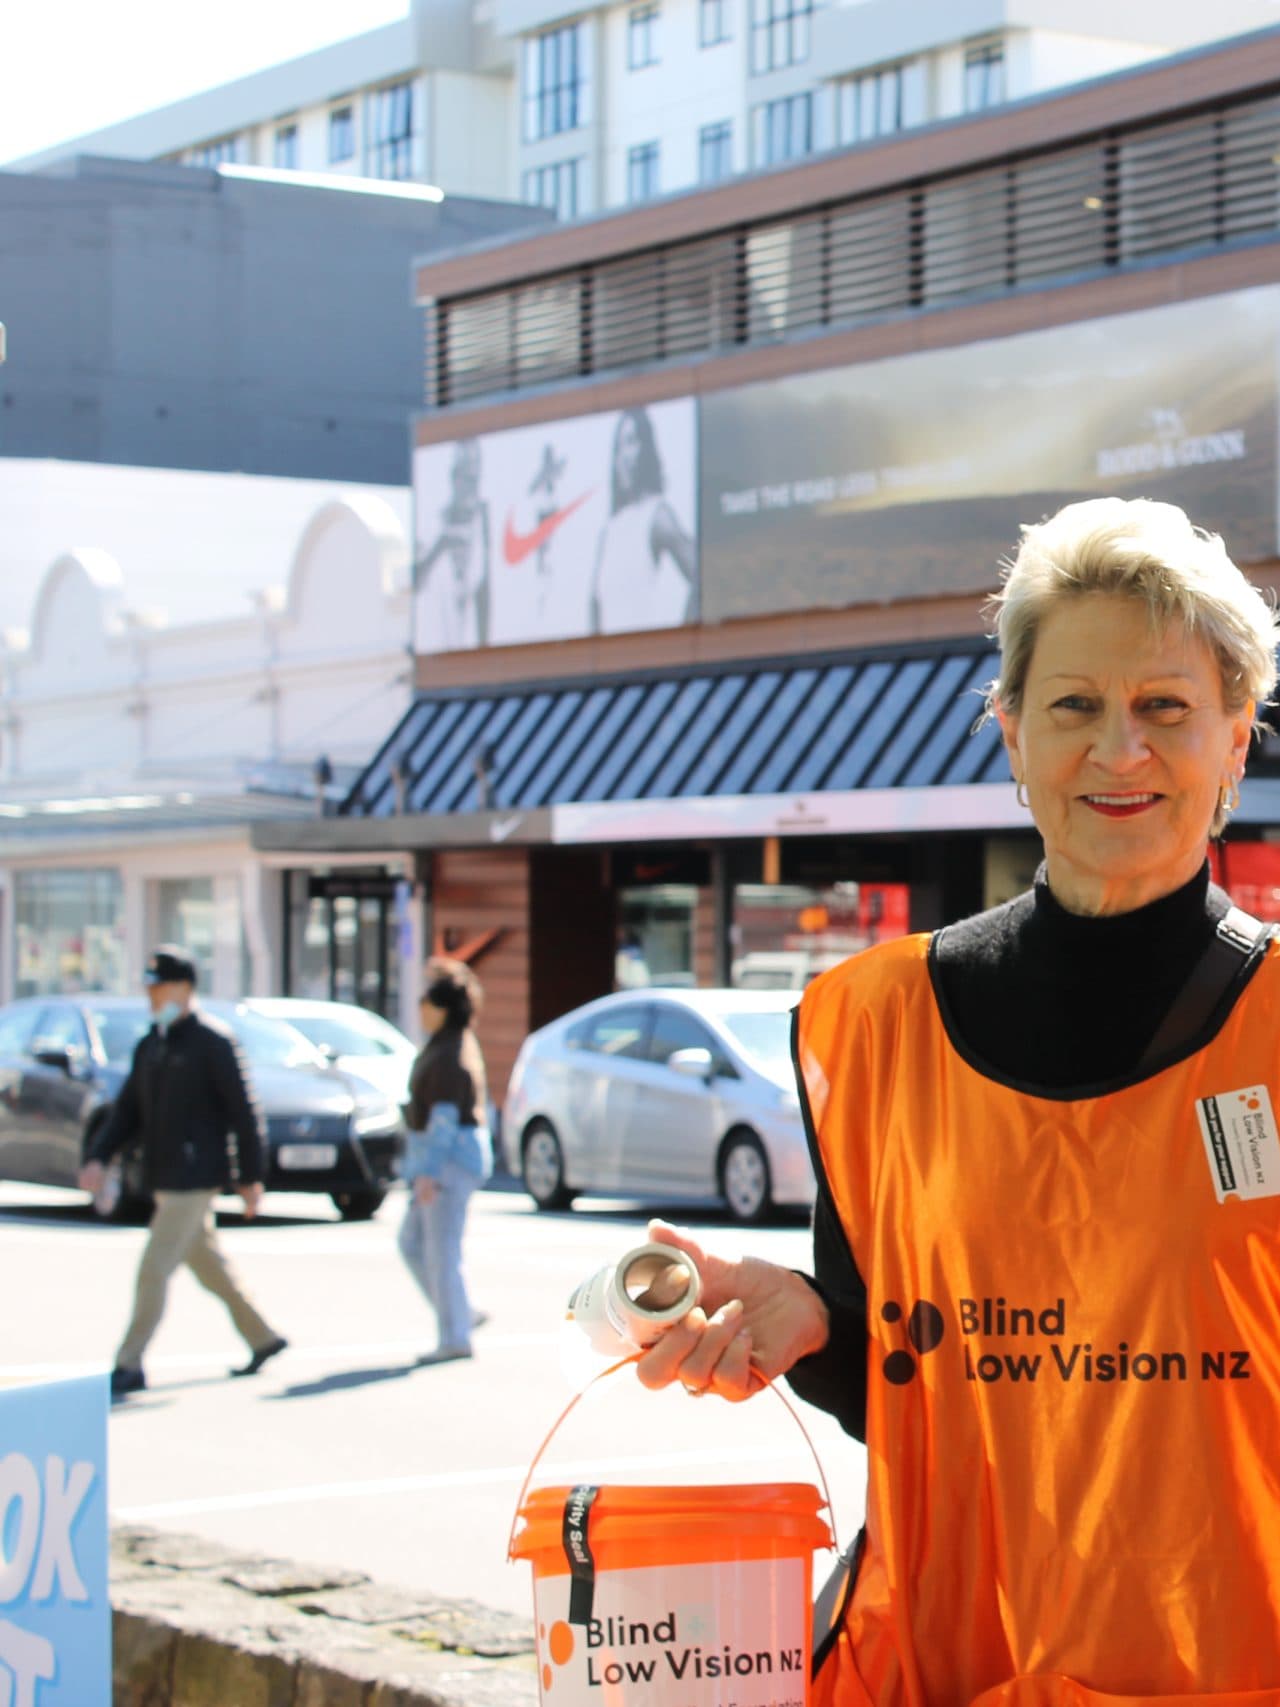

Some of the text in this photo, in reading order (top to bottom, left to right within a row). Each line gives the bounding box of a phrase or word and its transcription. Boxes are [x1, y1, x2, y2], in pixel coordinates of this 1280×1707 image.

[1254, 1113, 1268, 1139] Blind
[1243, 1114, 1265, 1184] Low Vision NZ
[960, 1298, 1065, 1336] Blind
[964, 1342, 1250, 1382] Low Vision NZ
[570, 1530, 590, 1563] Seal
[586, 1612, 676, 1648] Blind
[588, 1646, 803, 1686] Low Vision NZ
